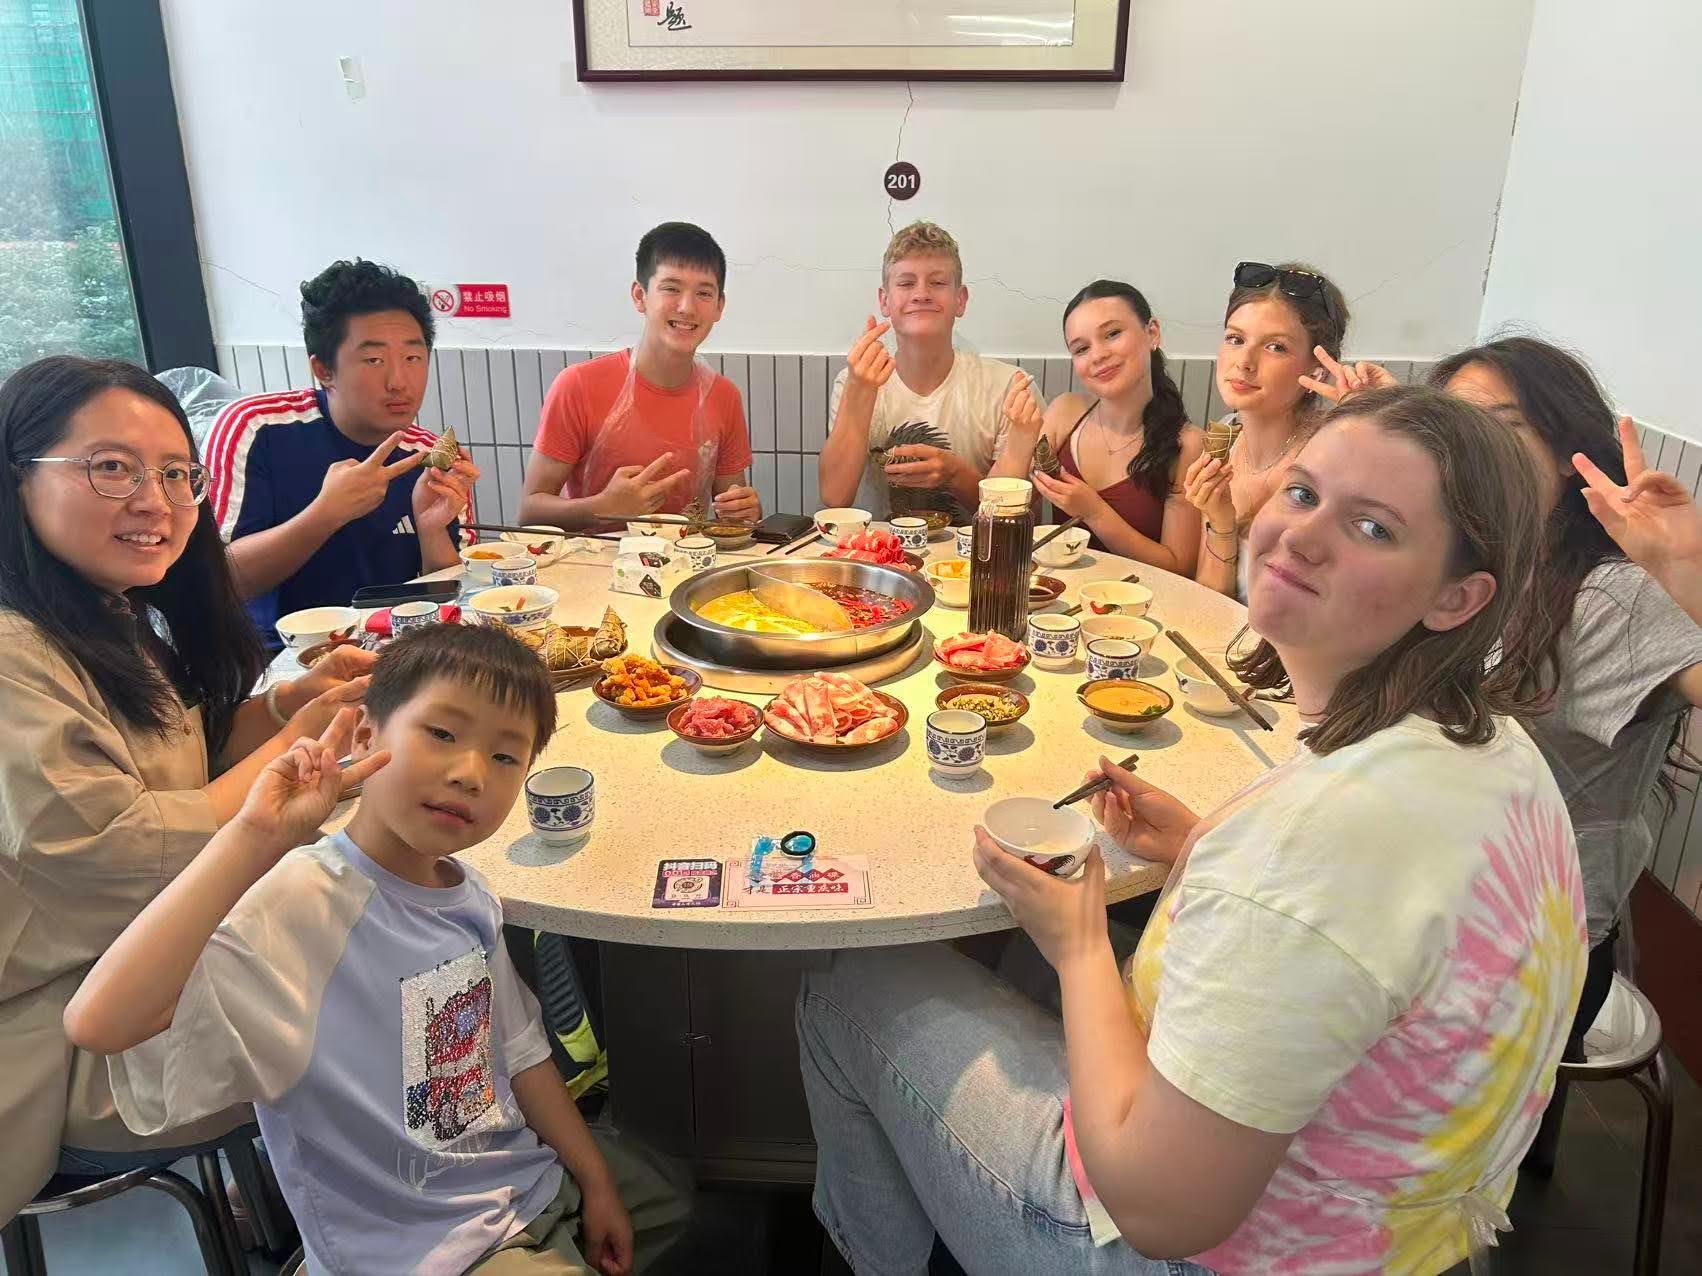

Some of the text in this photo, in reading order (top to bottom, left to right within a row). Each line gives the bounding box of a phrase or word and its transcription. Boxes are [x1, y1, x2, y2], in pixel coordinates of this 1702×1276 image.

[887, 174, 916, 189] 201
[462, 291, 506, 303] 禁止吸烟
[464, 304, 508, 314] No Smoking
[778, 883, 845, 895] 正宗重庆味
